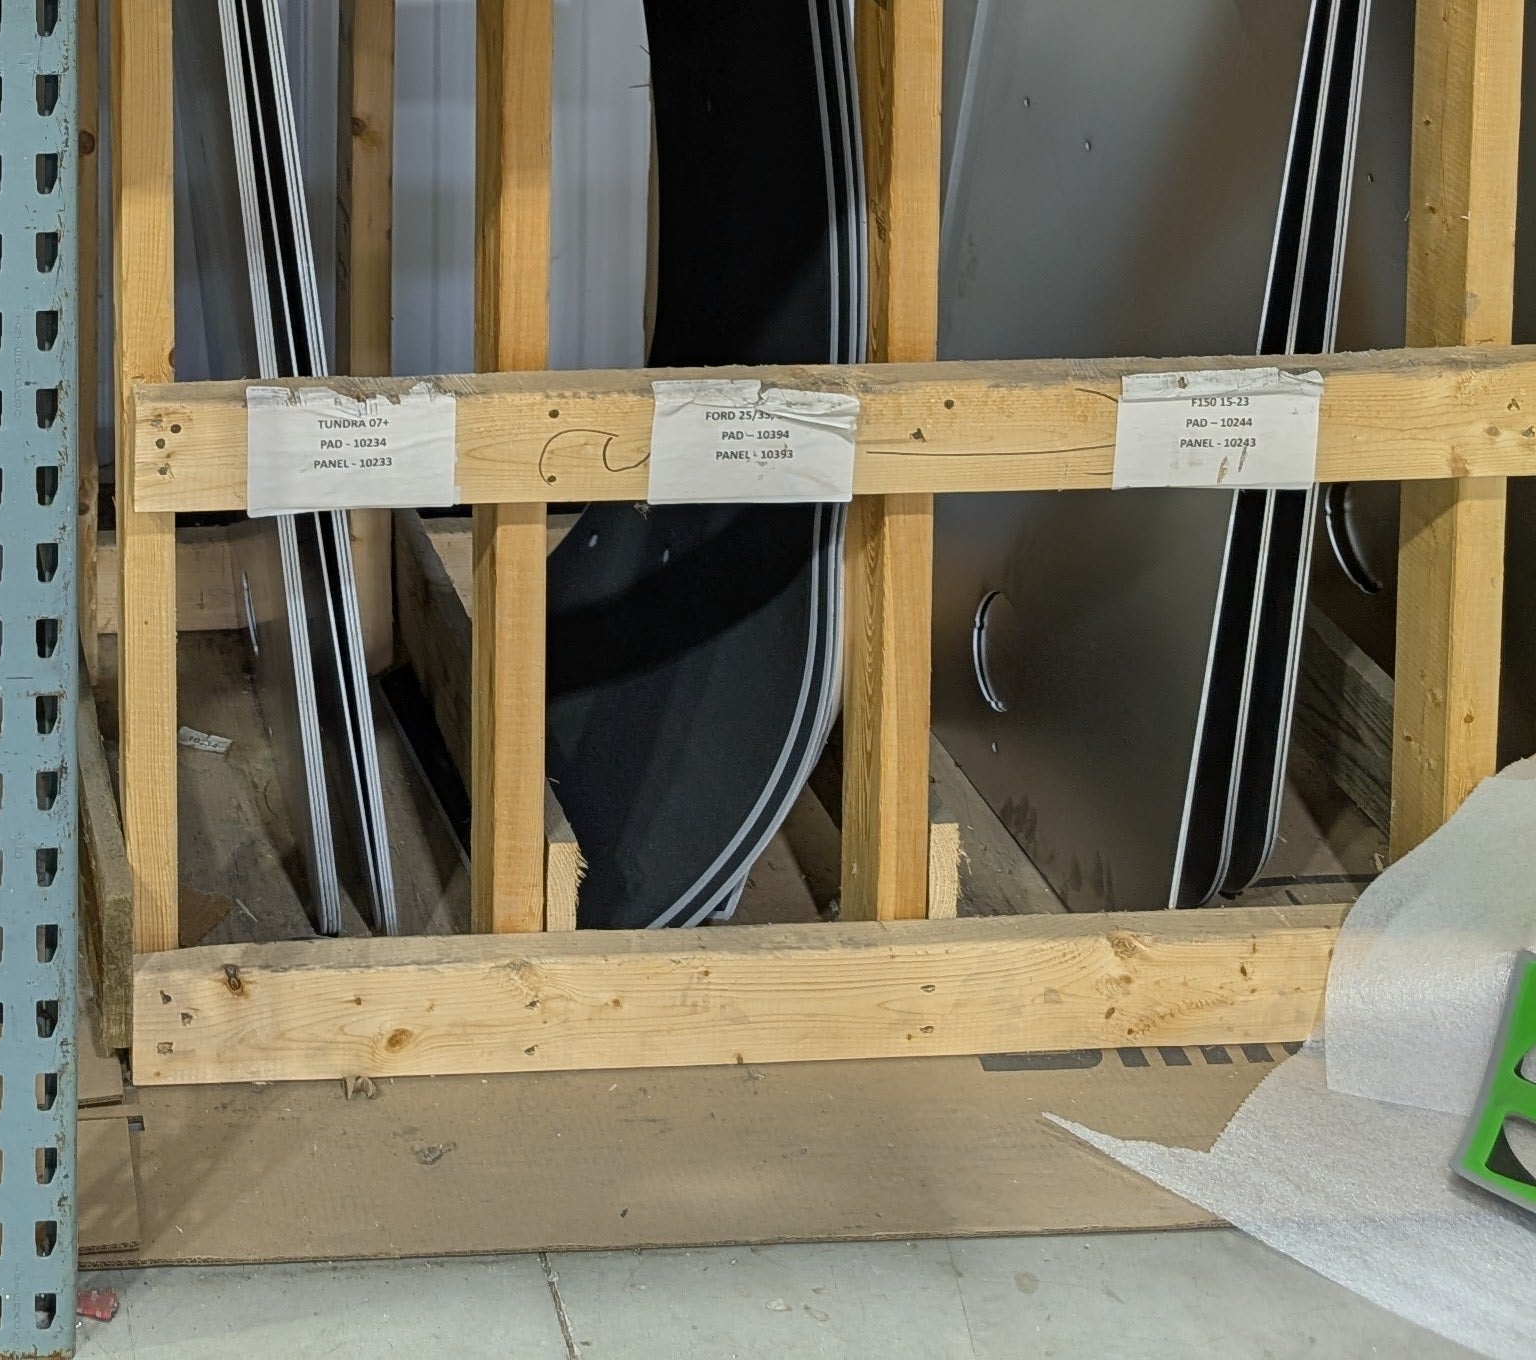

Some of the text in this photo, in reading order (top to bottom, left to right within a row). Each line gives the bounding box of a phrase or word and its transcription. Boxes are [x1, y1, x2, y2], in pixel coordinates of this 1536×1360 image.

[1190, 395, 1250, 408] F150 15-23
[705, 410, 736, 421] FORD
[318, 417, 390, 429] TUNDRA 07+
[1185, 418, 1208, 428] PAD
[1220, 417, 1253, 428] 10244
[721, 430, 745, 441] PAD
[756, 429, 790, 440] 10394
[320, 439, 343, 450] PAD
[353, 437, 387, 448] 10234
[1179, 438, 1215, 448] PANEL
[1223, 437, 1257, 450] 10243
[715, 450, 751, 460] PANEL
[760, 446, 794, 460] 10393
[313, 459, 350, 470] PANEL
[359, 456, 393, 468] 10233
